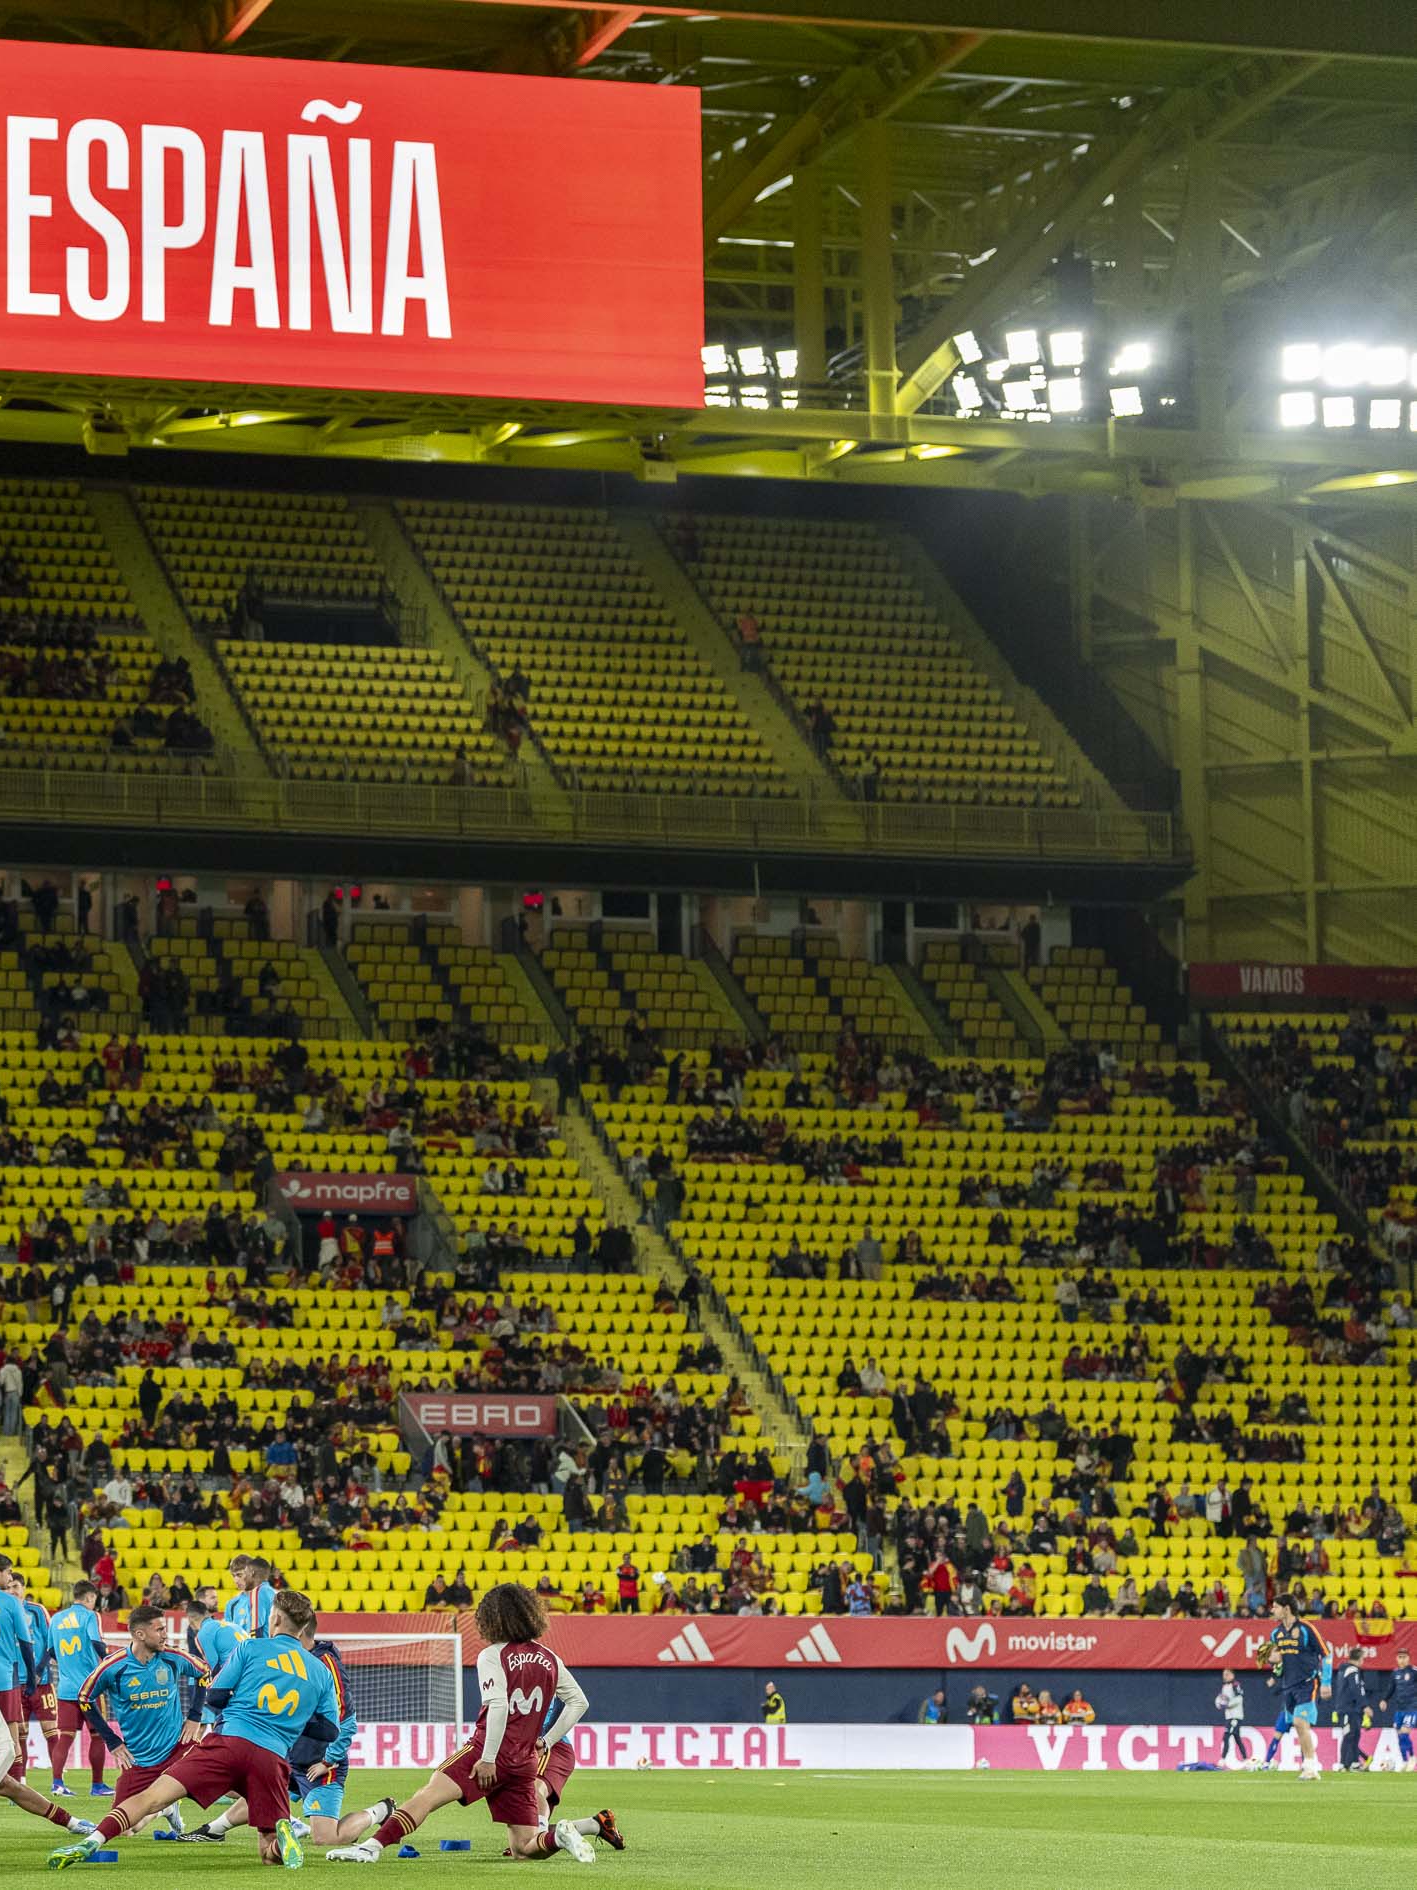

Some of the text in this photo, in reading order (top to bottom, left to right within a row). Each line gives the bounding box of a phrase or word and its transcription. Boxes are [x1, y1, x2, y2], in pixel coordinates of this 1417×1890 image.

[6, 99, 452, 339] ESPAÑA
[1240, 967, 1305, 993] VAMOS
[315, 1182, 410, 1203] mapfre
[420, 1404, 541, 1427] EBRO
[1008, 1632, 1098, 1651] movistar
[507, 1651, 552, 1671] España
[40, 1694, 56, 1710] 18
[573, 1726, 801, 1767] OFICIAL
